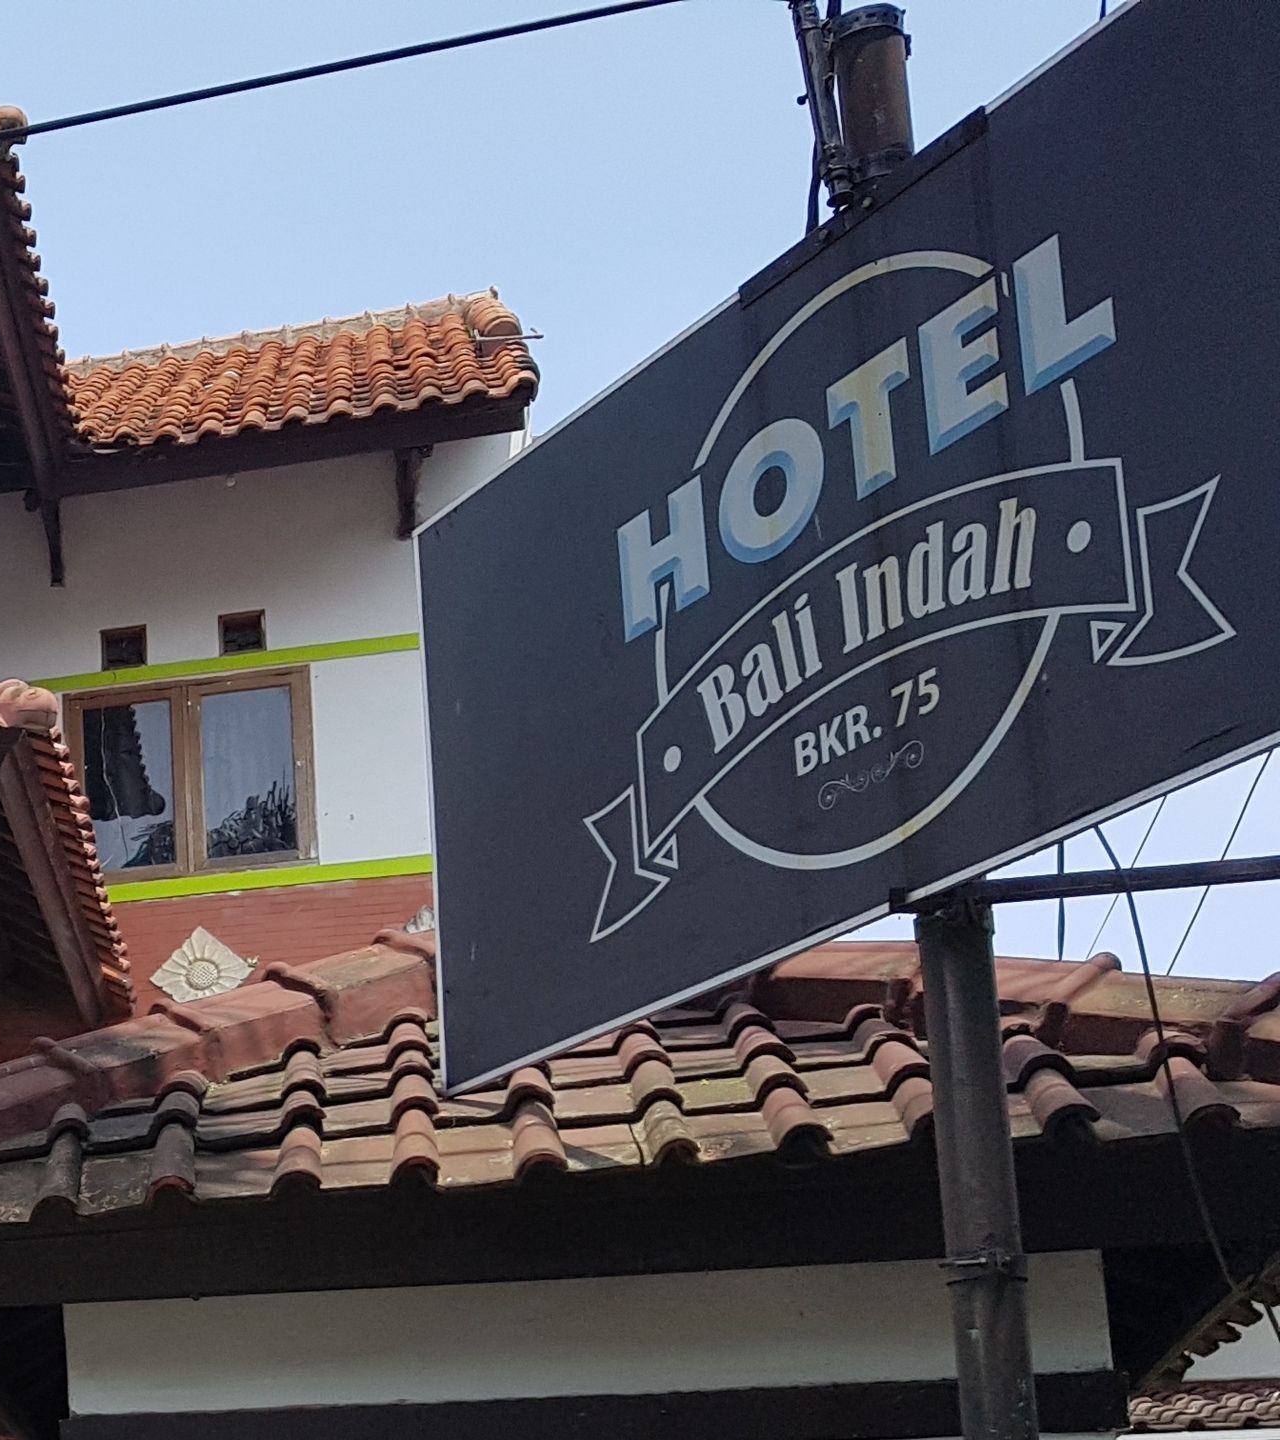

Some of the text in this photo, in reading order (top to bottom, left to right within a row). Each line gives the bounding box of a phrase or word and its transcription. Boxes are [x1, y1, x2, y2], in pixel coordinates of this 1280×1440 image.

[616, 232, 1119, 643] HOTEL
[696, 496, 1040, 755] Bali Indah
[792, 667, 941, 779] BKR. 75
